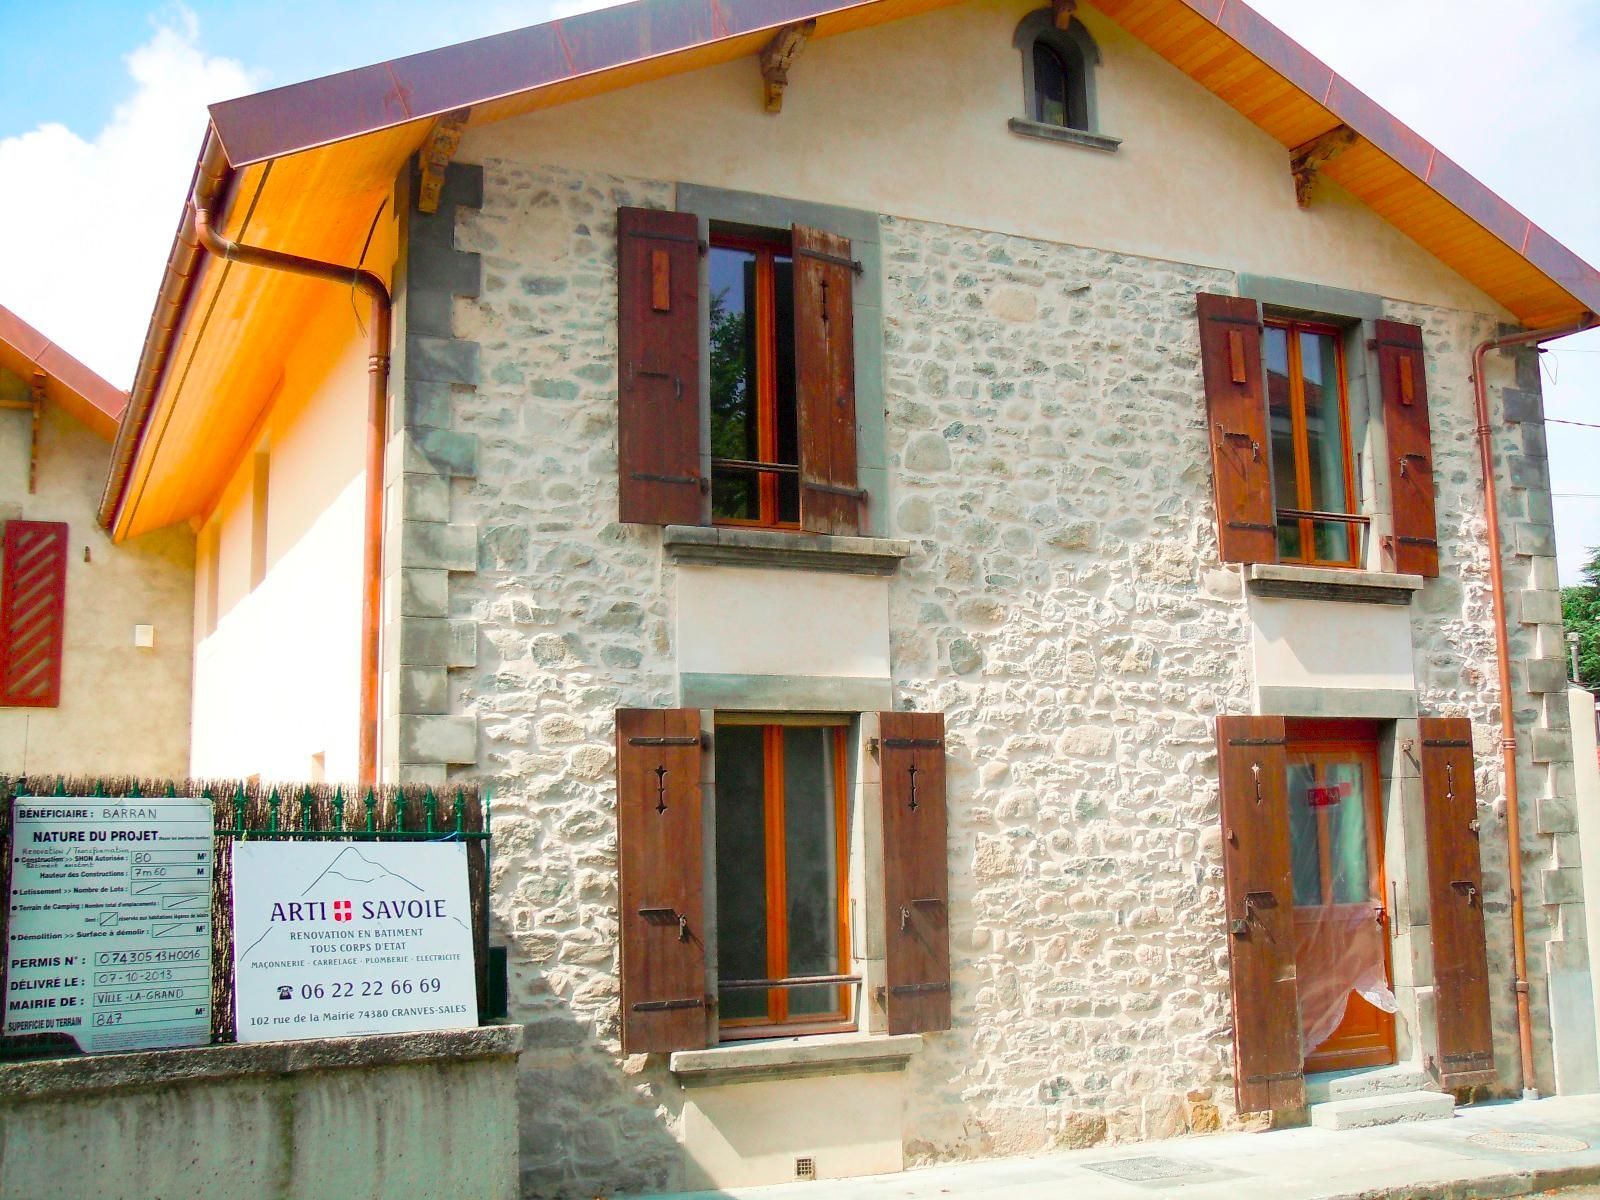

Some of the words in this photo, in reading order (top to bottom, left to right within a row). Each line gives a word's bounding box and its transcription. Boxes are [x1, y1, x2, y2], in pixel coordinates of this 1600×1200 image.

[103, 808, 157, 819] BARRAN
[33, 831, 85, 843] NATURE
[89, 831, 107, 842] DU
[111, 830, 159, 841] PROJET
[20, 888, 62, 896] Lotissement
[52, 903, 80, 911] Camping
[270, 901, 327, 922] ARTI
[362, 899, 448, 920] SAVOIE
[290, 930, 355, 941] RENOVATION
[358, 930, 372, 939] EN
[374, 928, 424, 938] BATIMENT
[310, 944, 337, 954] TOUS
[339, 943, 372, 952] CORPS
[375, 942, 406, 951] D'ETAT
[11, 957, 61, 969] PERMIS
[251, 960, 305, 969] MAÇONNERIE
[313, 958, 358, 967] CARRELAGE
[365, 956, 409, 964] PLOMBERIE
[416, 953, 461, 962] ELECTRICITE
[10, 977, 61, 991] DÉLIVRÉ
[64, 977, 79, 987] LE
[301, 983, 325, 1000] 06
[332, 982, 354, 998] 22
[361, 980, 384, 997] 22
[391, 979, 413, 995] 66
[420, 977, 441, 993] 69
[9, 998, 56, 1011] MAIRIE
[60, 997, 77, 1007] DE
[250, 1016, 269, 1026] 102
[273, 1016, 290, 1025] rue
[294, 1014, 307, 1023] de
[310, 1013, 320, 1022] la
[323, 1011, 355, 1021] Mairie
[358, 1009, 389, 1019] 74380
[391, 1004, 467, 1018] CRANVES-SALES
[8, 1019, 45, 1032] SUPERFICIE
[45, 1018, 55, 1029] DU
[56, 1016, 82, 1028] TERRAIN
[96, 1012, 122, 1026] 847
